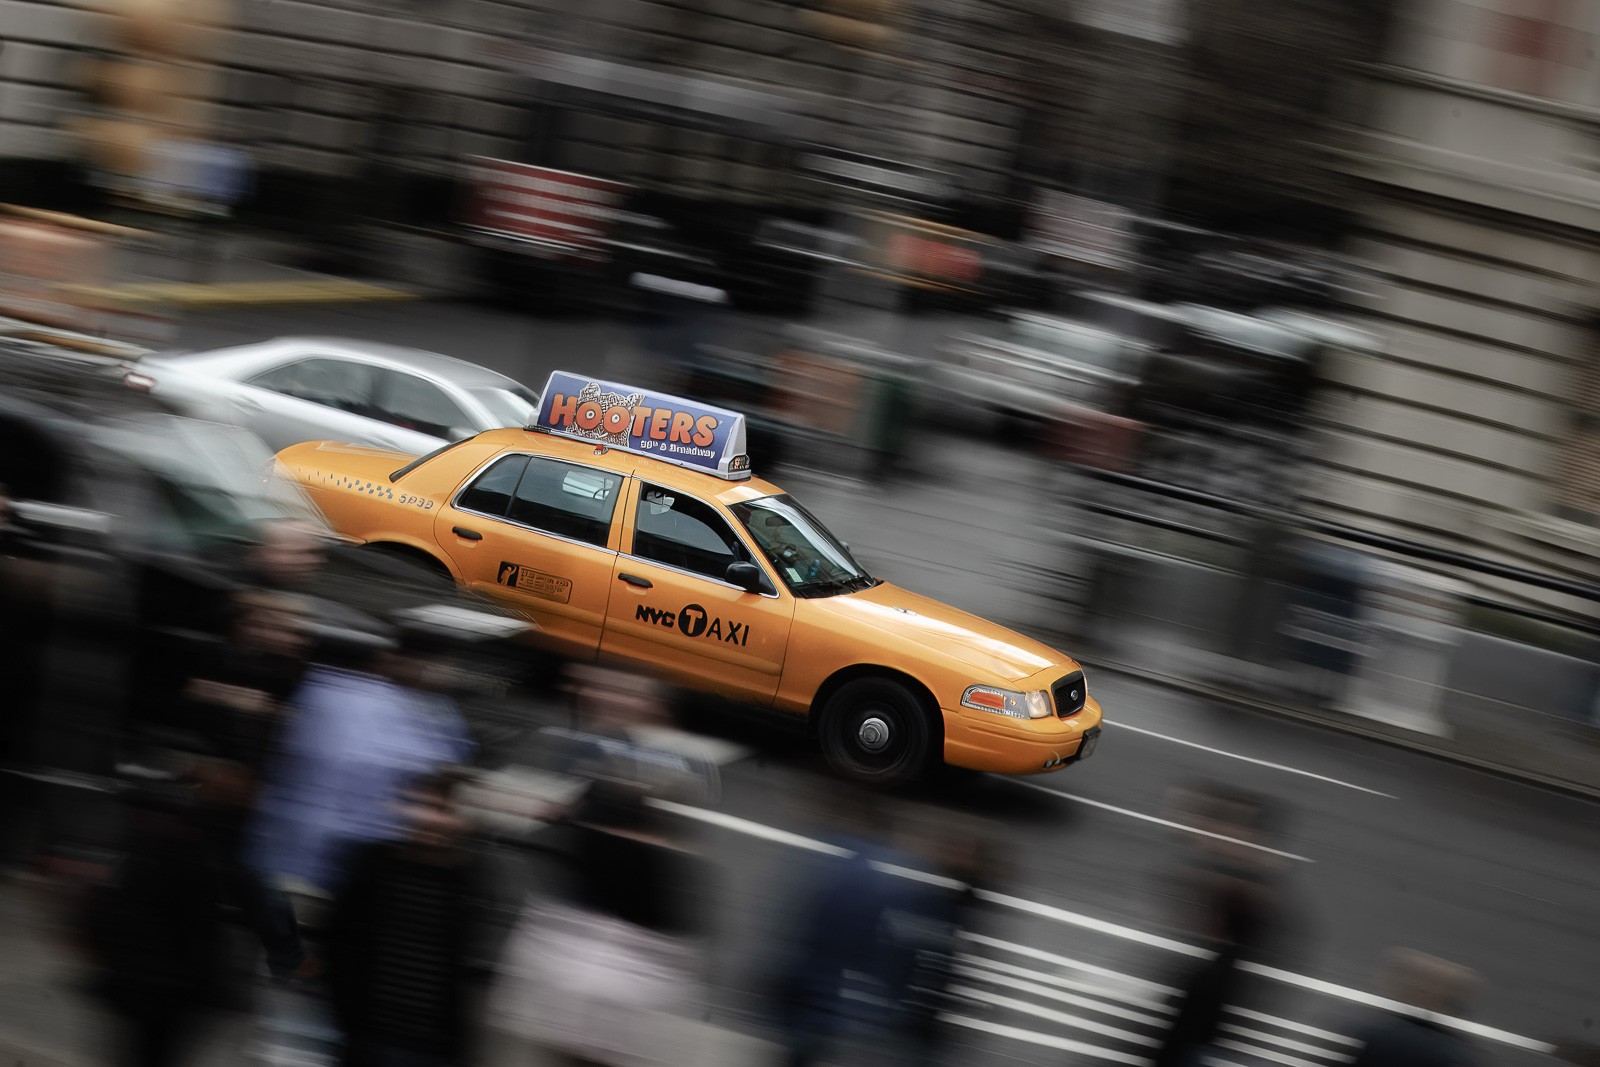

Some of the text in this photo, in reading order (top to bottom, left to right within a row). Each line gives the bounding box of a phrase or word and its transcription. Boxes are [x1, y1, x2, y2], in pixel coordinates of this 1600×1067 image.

[549, 393, 718, 447] HOOTERS
[669, 443, 716, 459] Broadway
[635, 603, 750, 647] NYC TAXI
